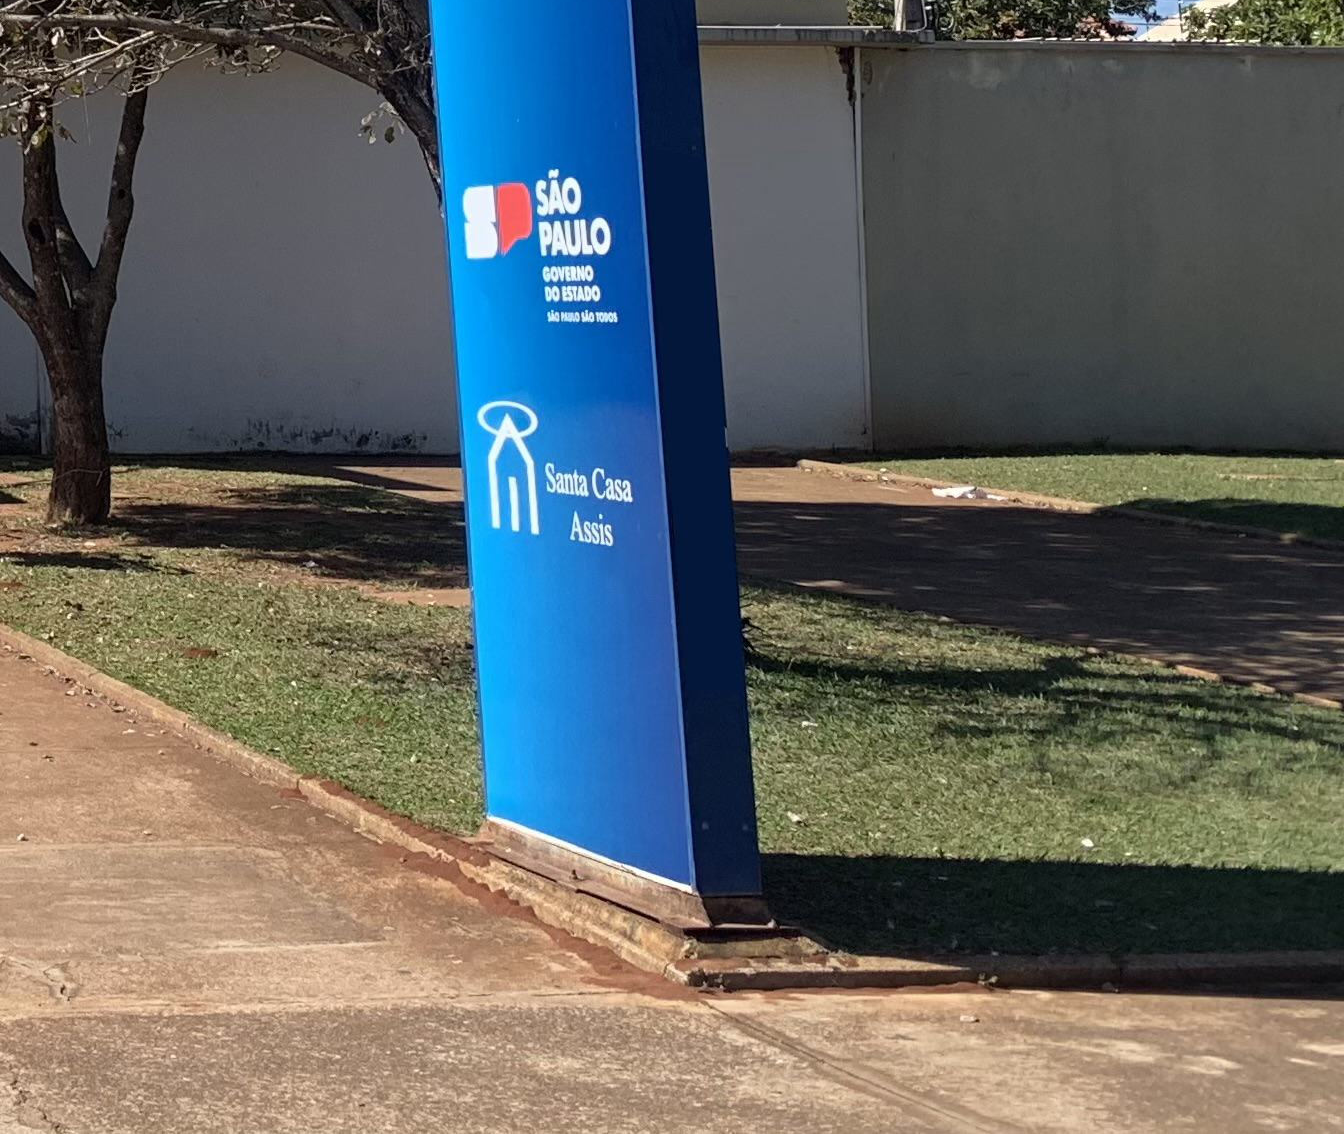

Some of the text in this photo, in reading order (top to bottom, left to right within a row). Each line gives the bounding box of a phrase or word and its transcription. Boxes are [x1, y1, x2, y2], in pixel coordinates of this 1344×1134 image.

[535, 169, 581, 216] SÃO
[538, 217, 611, 256] PAULO
[542, 265, 593, 282] GOVERNO
[544, 285, 600, 302] DO ESTADO
[547, 310, 618, 323] SÃO PAULO SÃO TODOS
[545, 462, 633, 503] Santa Casa
[570, 510, 613, 546] Assis
